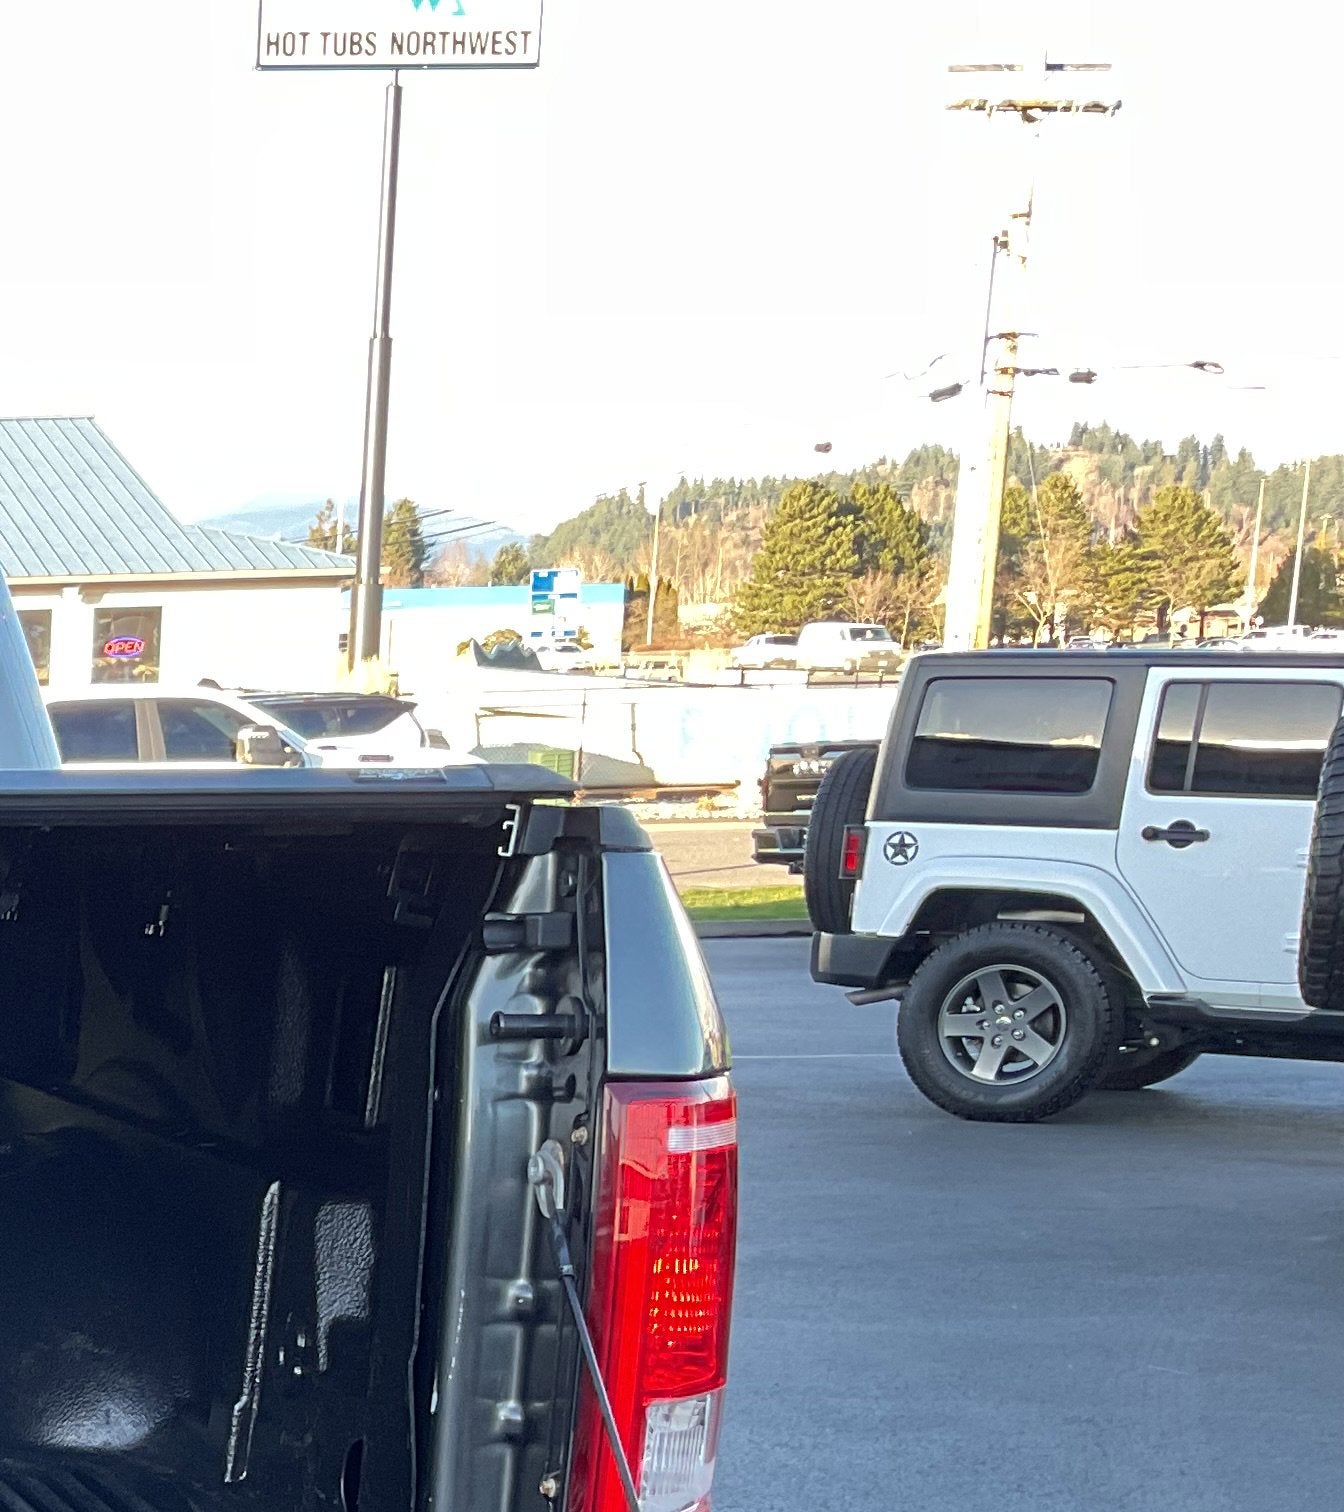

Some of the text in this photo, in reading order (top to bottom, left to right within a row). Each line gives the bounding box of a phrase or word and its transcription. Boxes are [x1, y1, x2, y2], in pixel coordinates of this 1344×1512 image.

[266, 30, 533, 57] HOT TUBS NORTHWEST
[104, 640, 145, 654] OPEN
